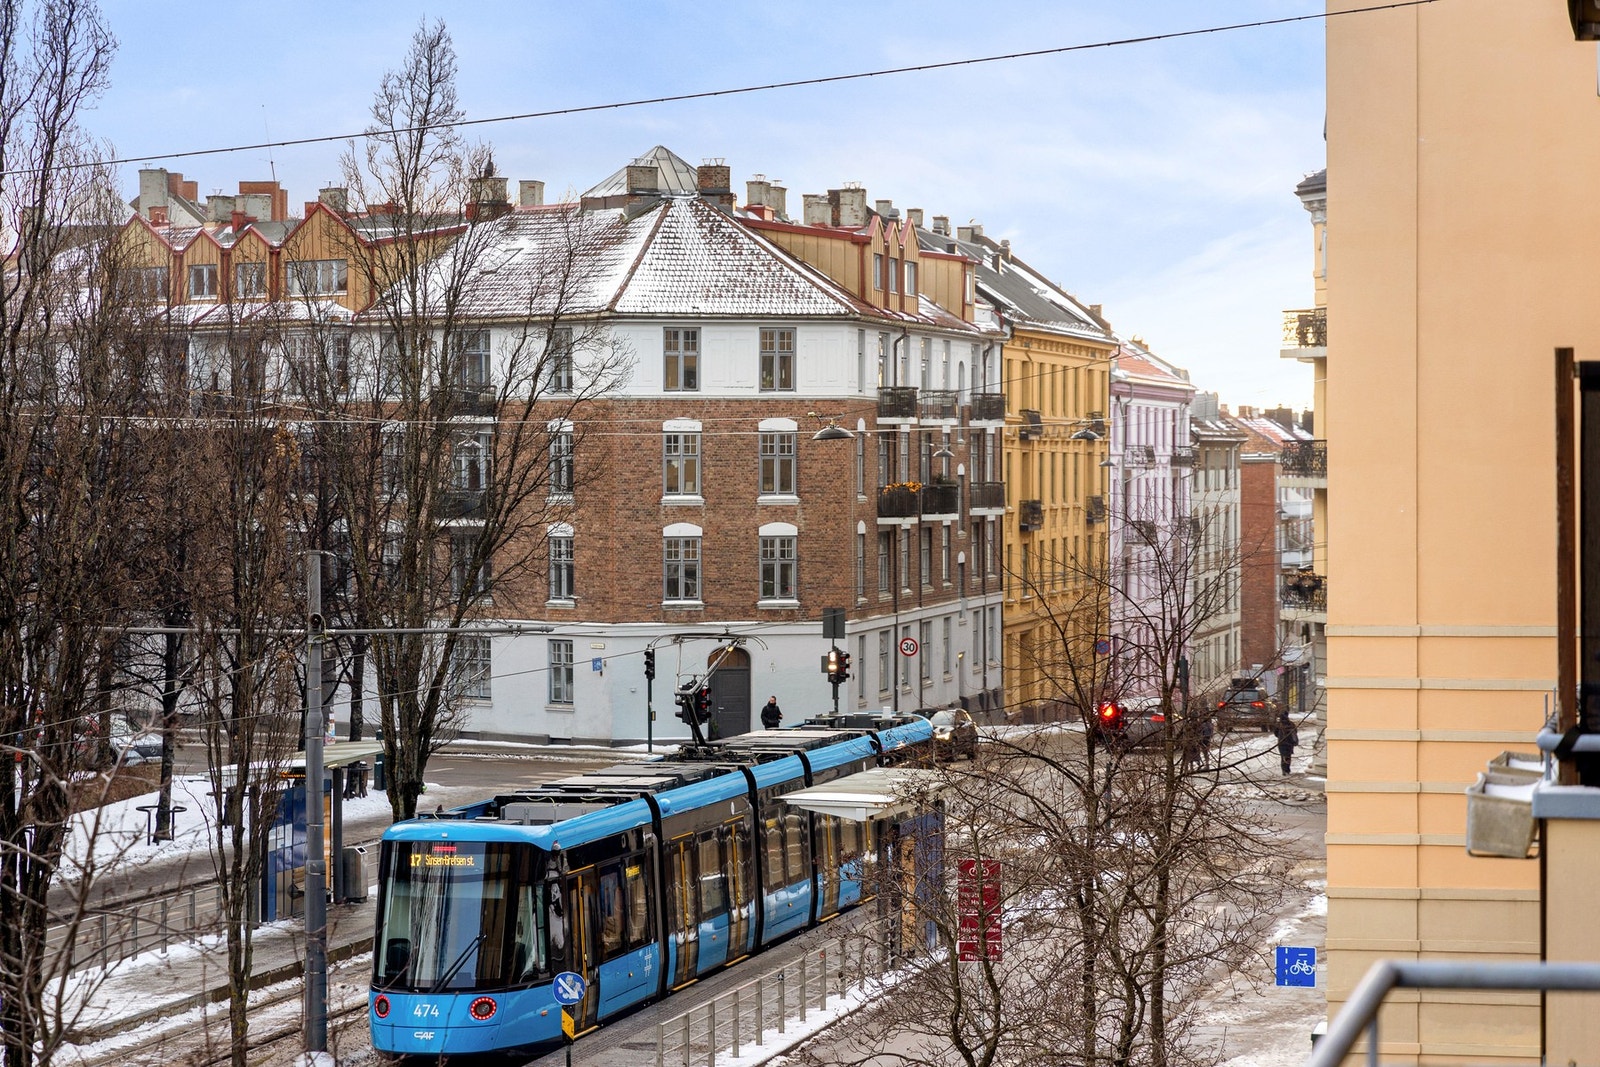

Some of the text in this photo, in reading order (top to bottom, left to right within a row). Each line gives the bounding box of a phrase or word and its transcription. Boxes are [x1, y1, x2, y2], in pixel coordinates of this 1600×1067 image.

[903, 642, 915, 652] 30
[410, 853, 421, 866] 17
[413, 1004, 440, 1017] 474
[413, 1031, 435, 1040] CAF
